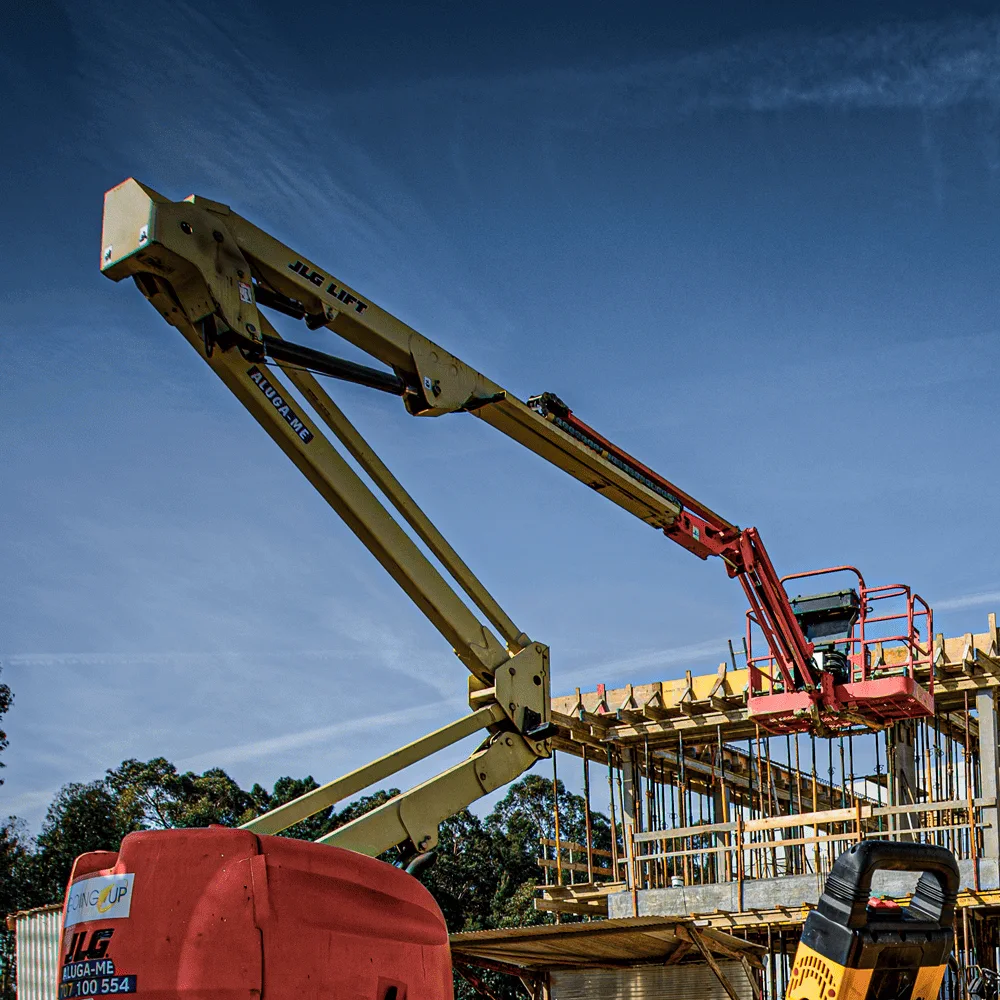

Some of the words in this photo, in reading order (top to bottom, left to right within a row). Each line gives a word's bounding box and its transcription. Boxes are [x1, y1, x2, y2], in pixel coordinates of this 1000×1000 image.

[288, 260, 325, 287] JLG
[326, 282, 368, 314] LIFT
[251, 372, 309, 440] ALUGA-ME
[109, 886, 128, 904] UP
[64, 929, 114, 964] JLG
[62, 960, 114, 980] ALUGA-ME
[76, 980, 97, 997] 100
[101, 977, 129, 993] 554
